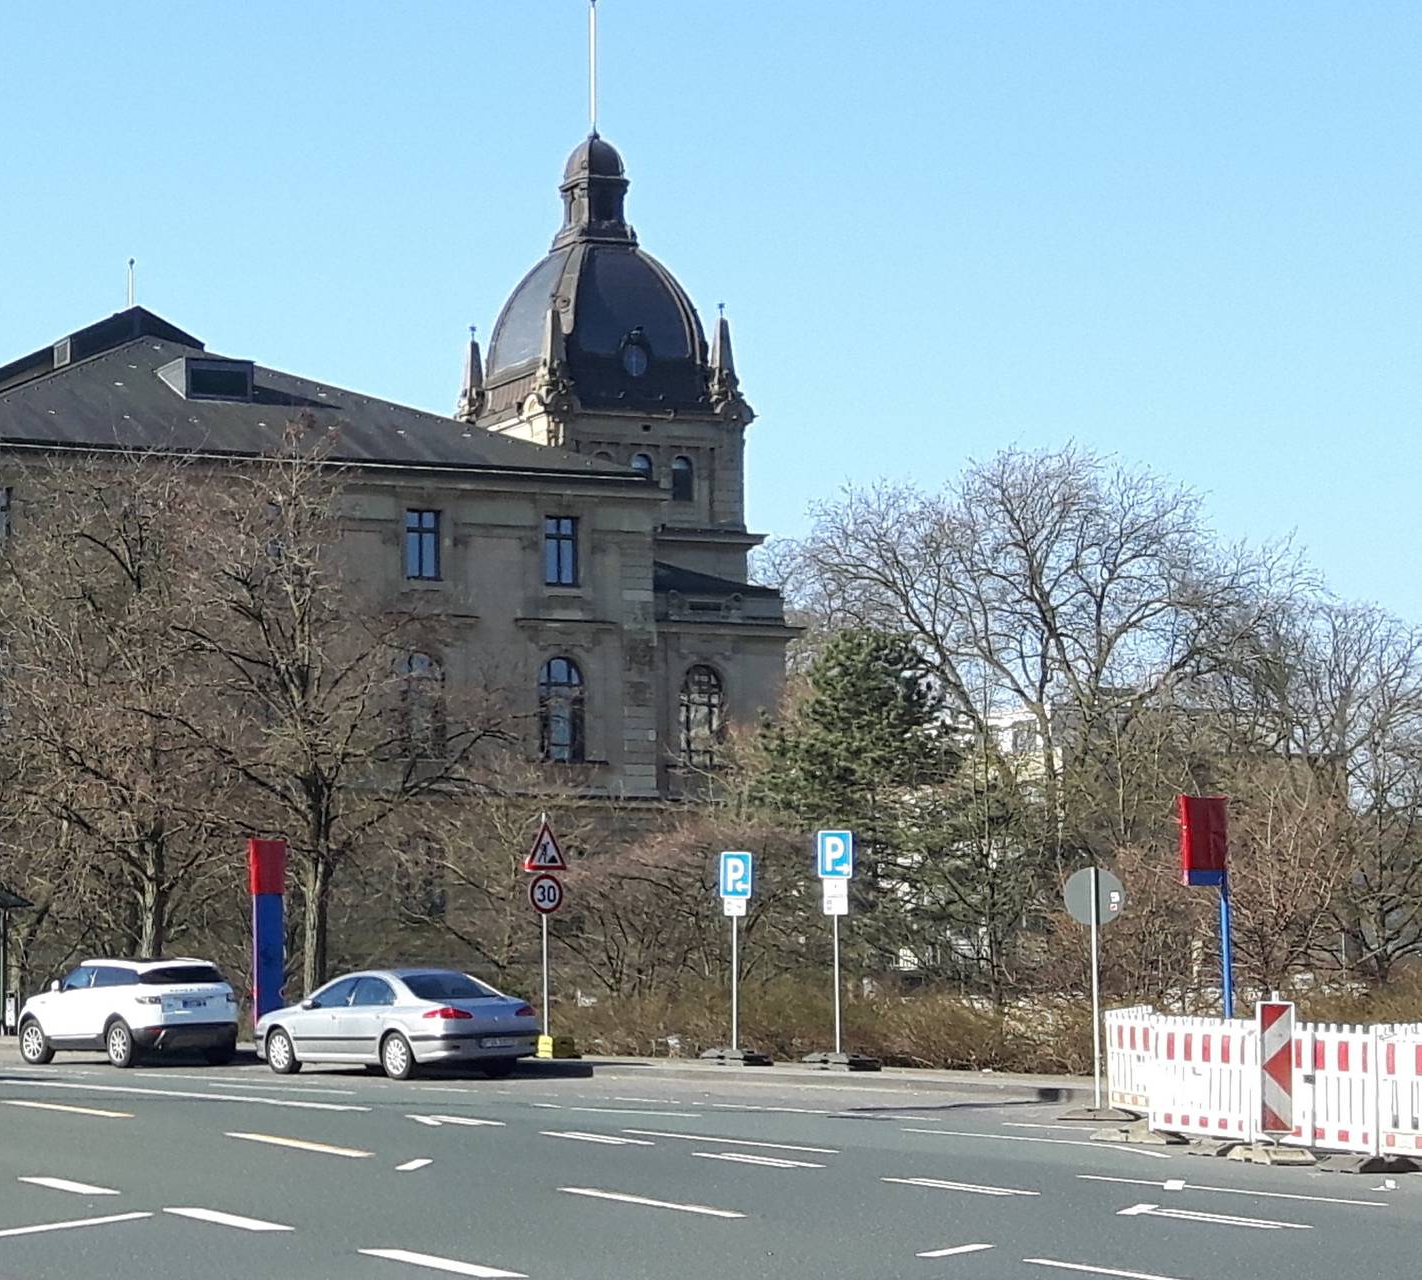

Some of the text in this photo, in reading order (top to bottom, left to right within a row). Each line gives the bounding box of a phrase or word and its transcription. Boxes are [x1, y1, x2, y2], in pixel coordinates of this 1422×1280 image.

[825, 836, 845, 871] P
[726, 858, 745, 892] P
[537, 884, 556, 903] 30
